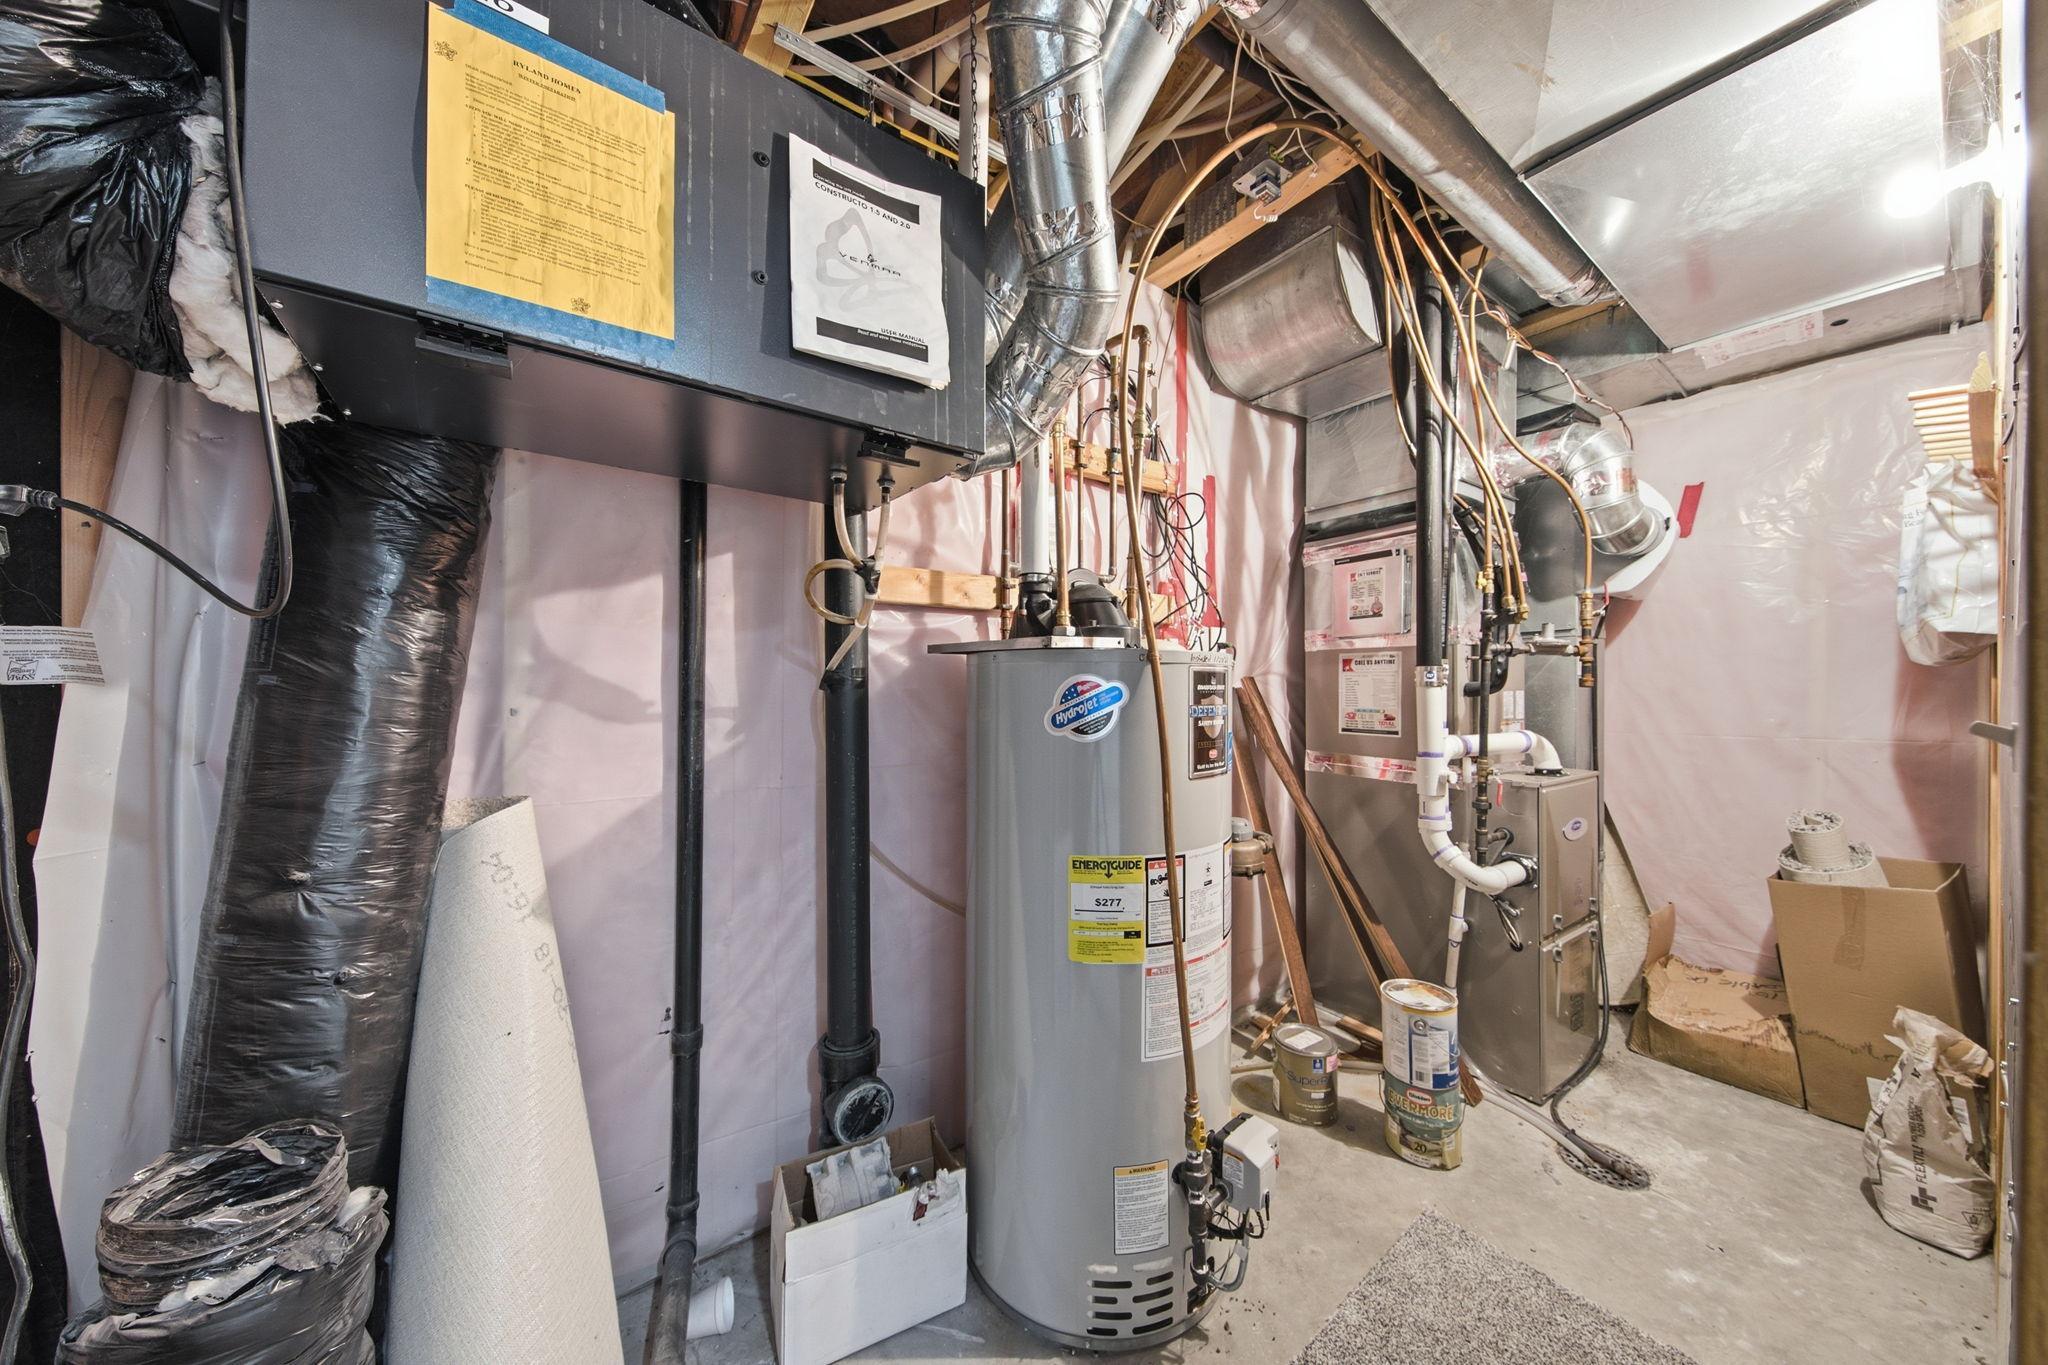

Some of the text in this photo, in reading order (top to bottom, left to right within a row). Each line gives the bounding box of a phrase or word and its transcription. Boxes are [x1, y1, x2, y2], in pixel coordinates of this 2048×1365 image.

[513, 60, 581, 94] RYLAND HOMES
[814, 180, 868, 209] CONSTRUCTO
[882, 212, 899, 225] AND
[881, 327, 926, 344] USER MANUAL
[1055, 697, 1098, 725] Hydrojet
